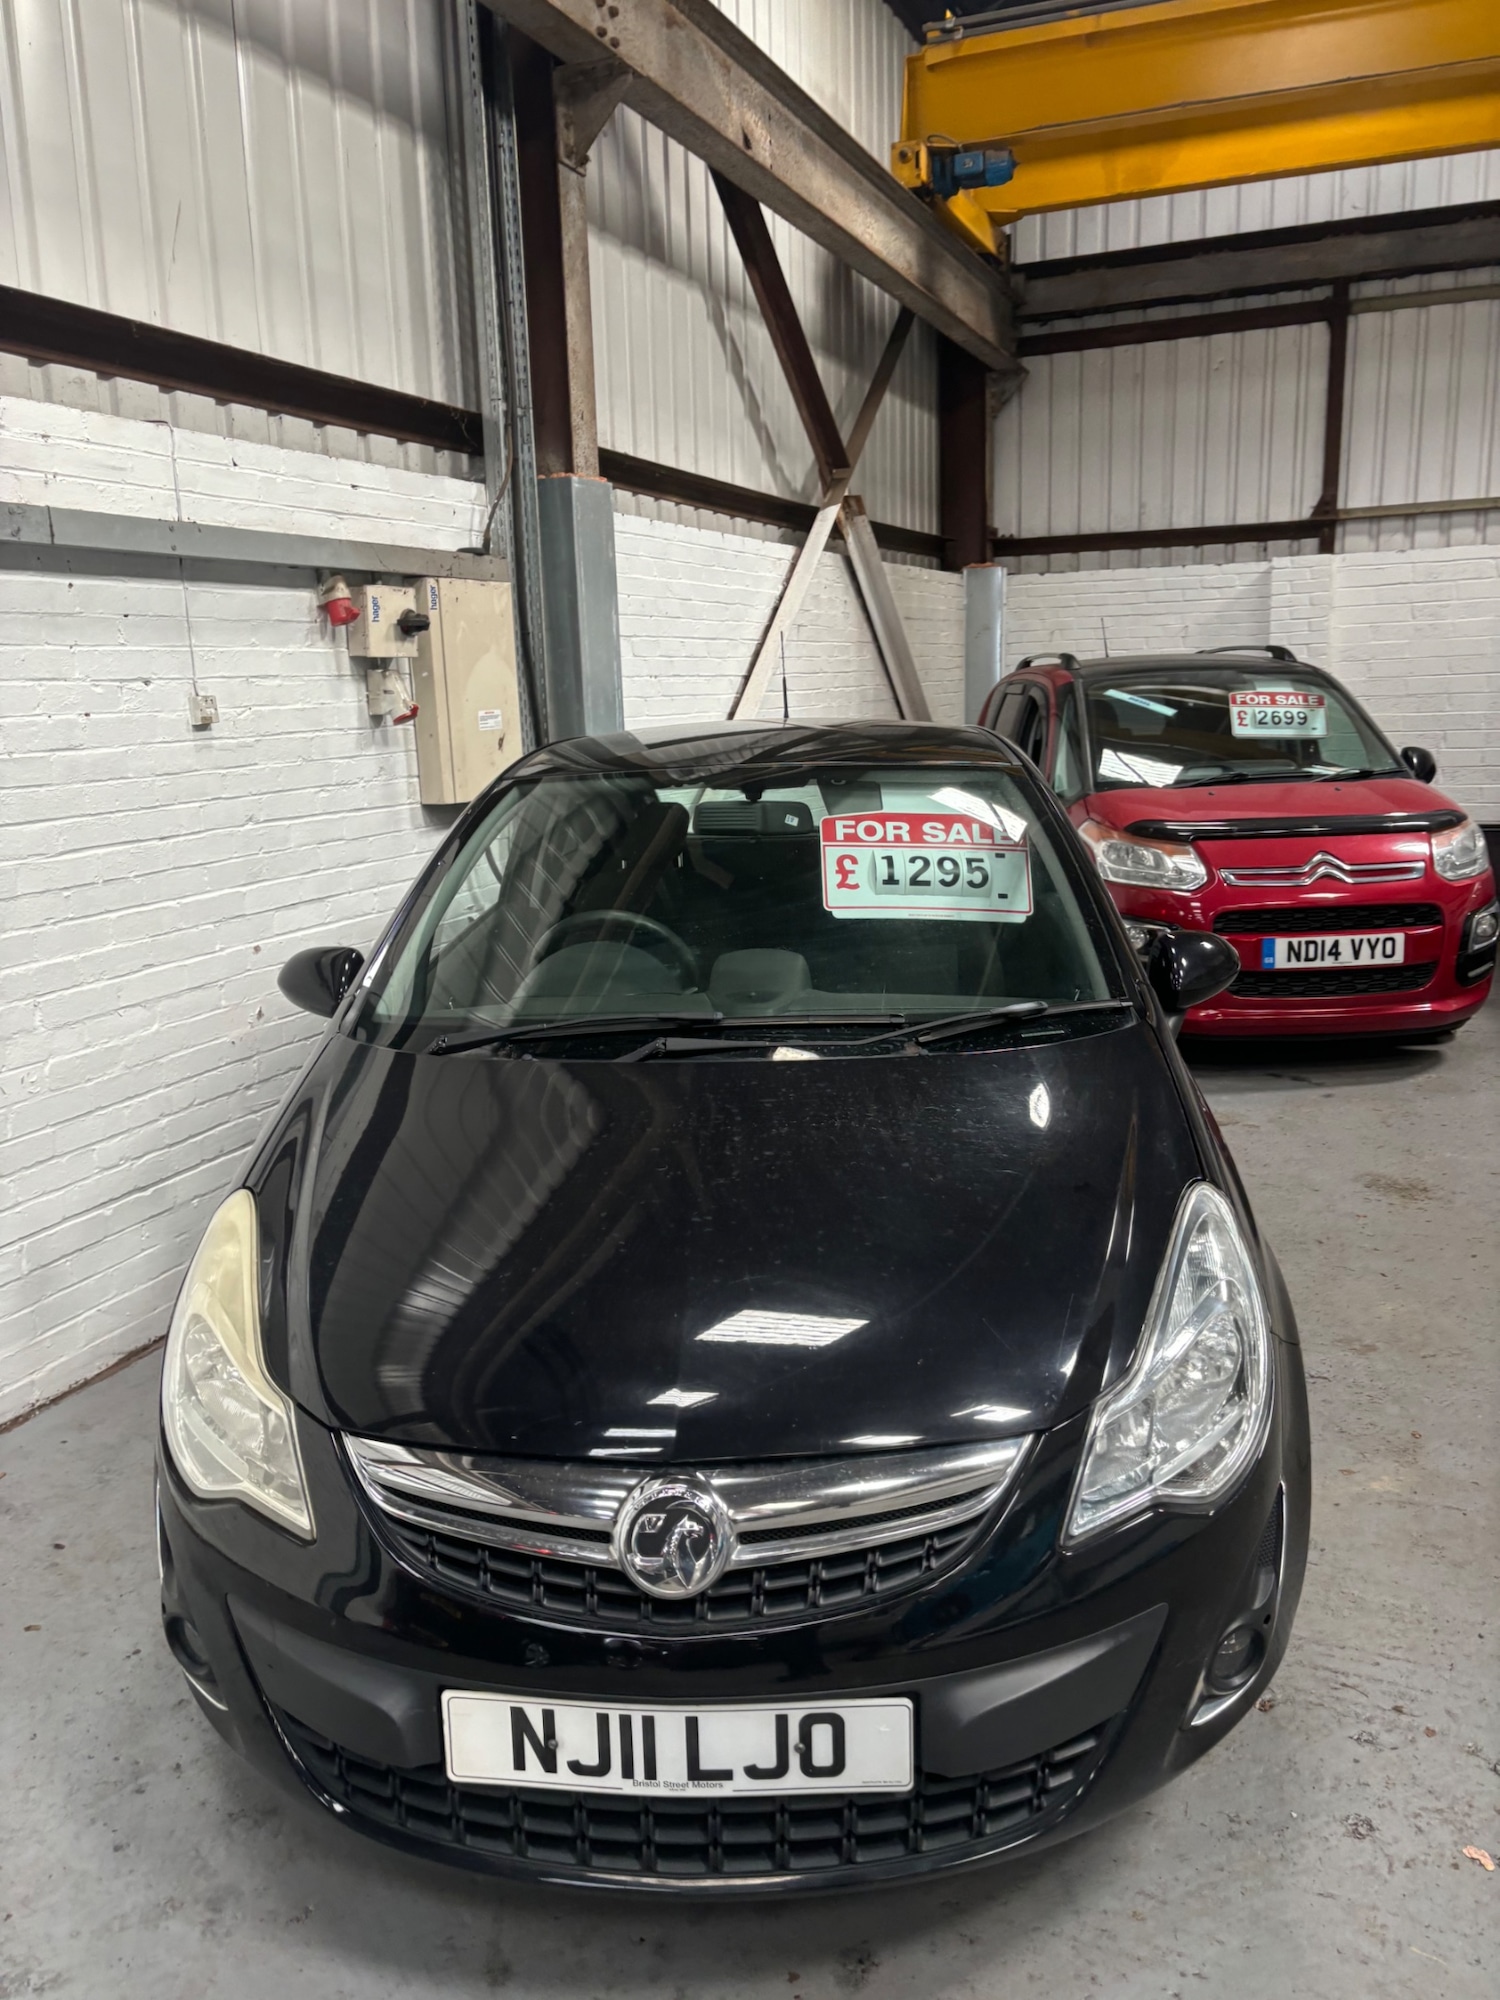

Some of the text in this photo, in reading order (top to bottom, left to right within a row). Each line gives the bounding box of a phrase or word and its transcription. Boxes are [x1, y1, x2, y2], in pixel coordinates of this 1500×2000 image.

[371, 596, 380, 623] hager
[430, 585, 438, 611] hager
[1236, 695, 1319, 705] FOR SALE
[1237, 710, 1307, 727] £ 2699
[835, 820, 910, 842] FOR
[835, 854, 989, 890] £ 1295
[1287, 937, 1396, 963] ND14 VYO
[510, 1706, 846, 1781] NJ11 LJO
[632, 1779, 724, 1789] Bristol Street Motors
